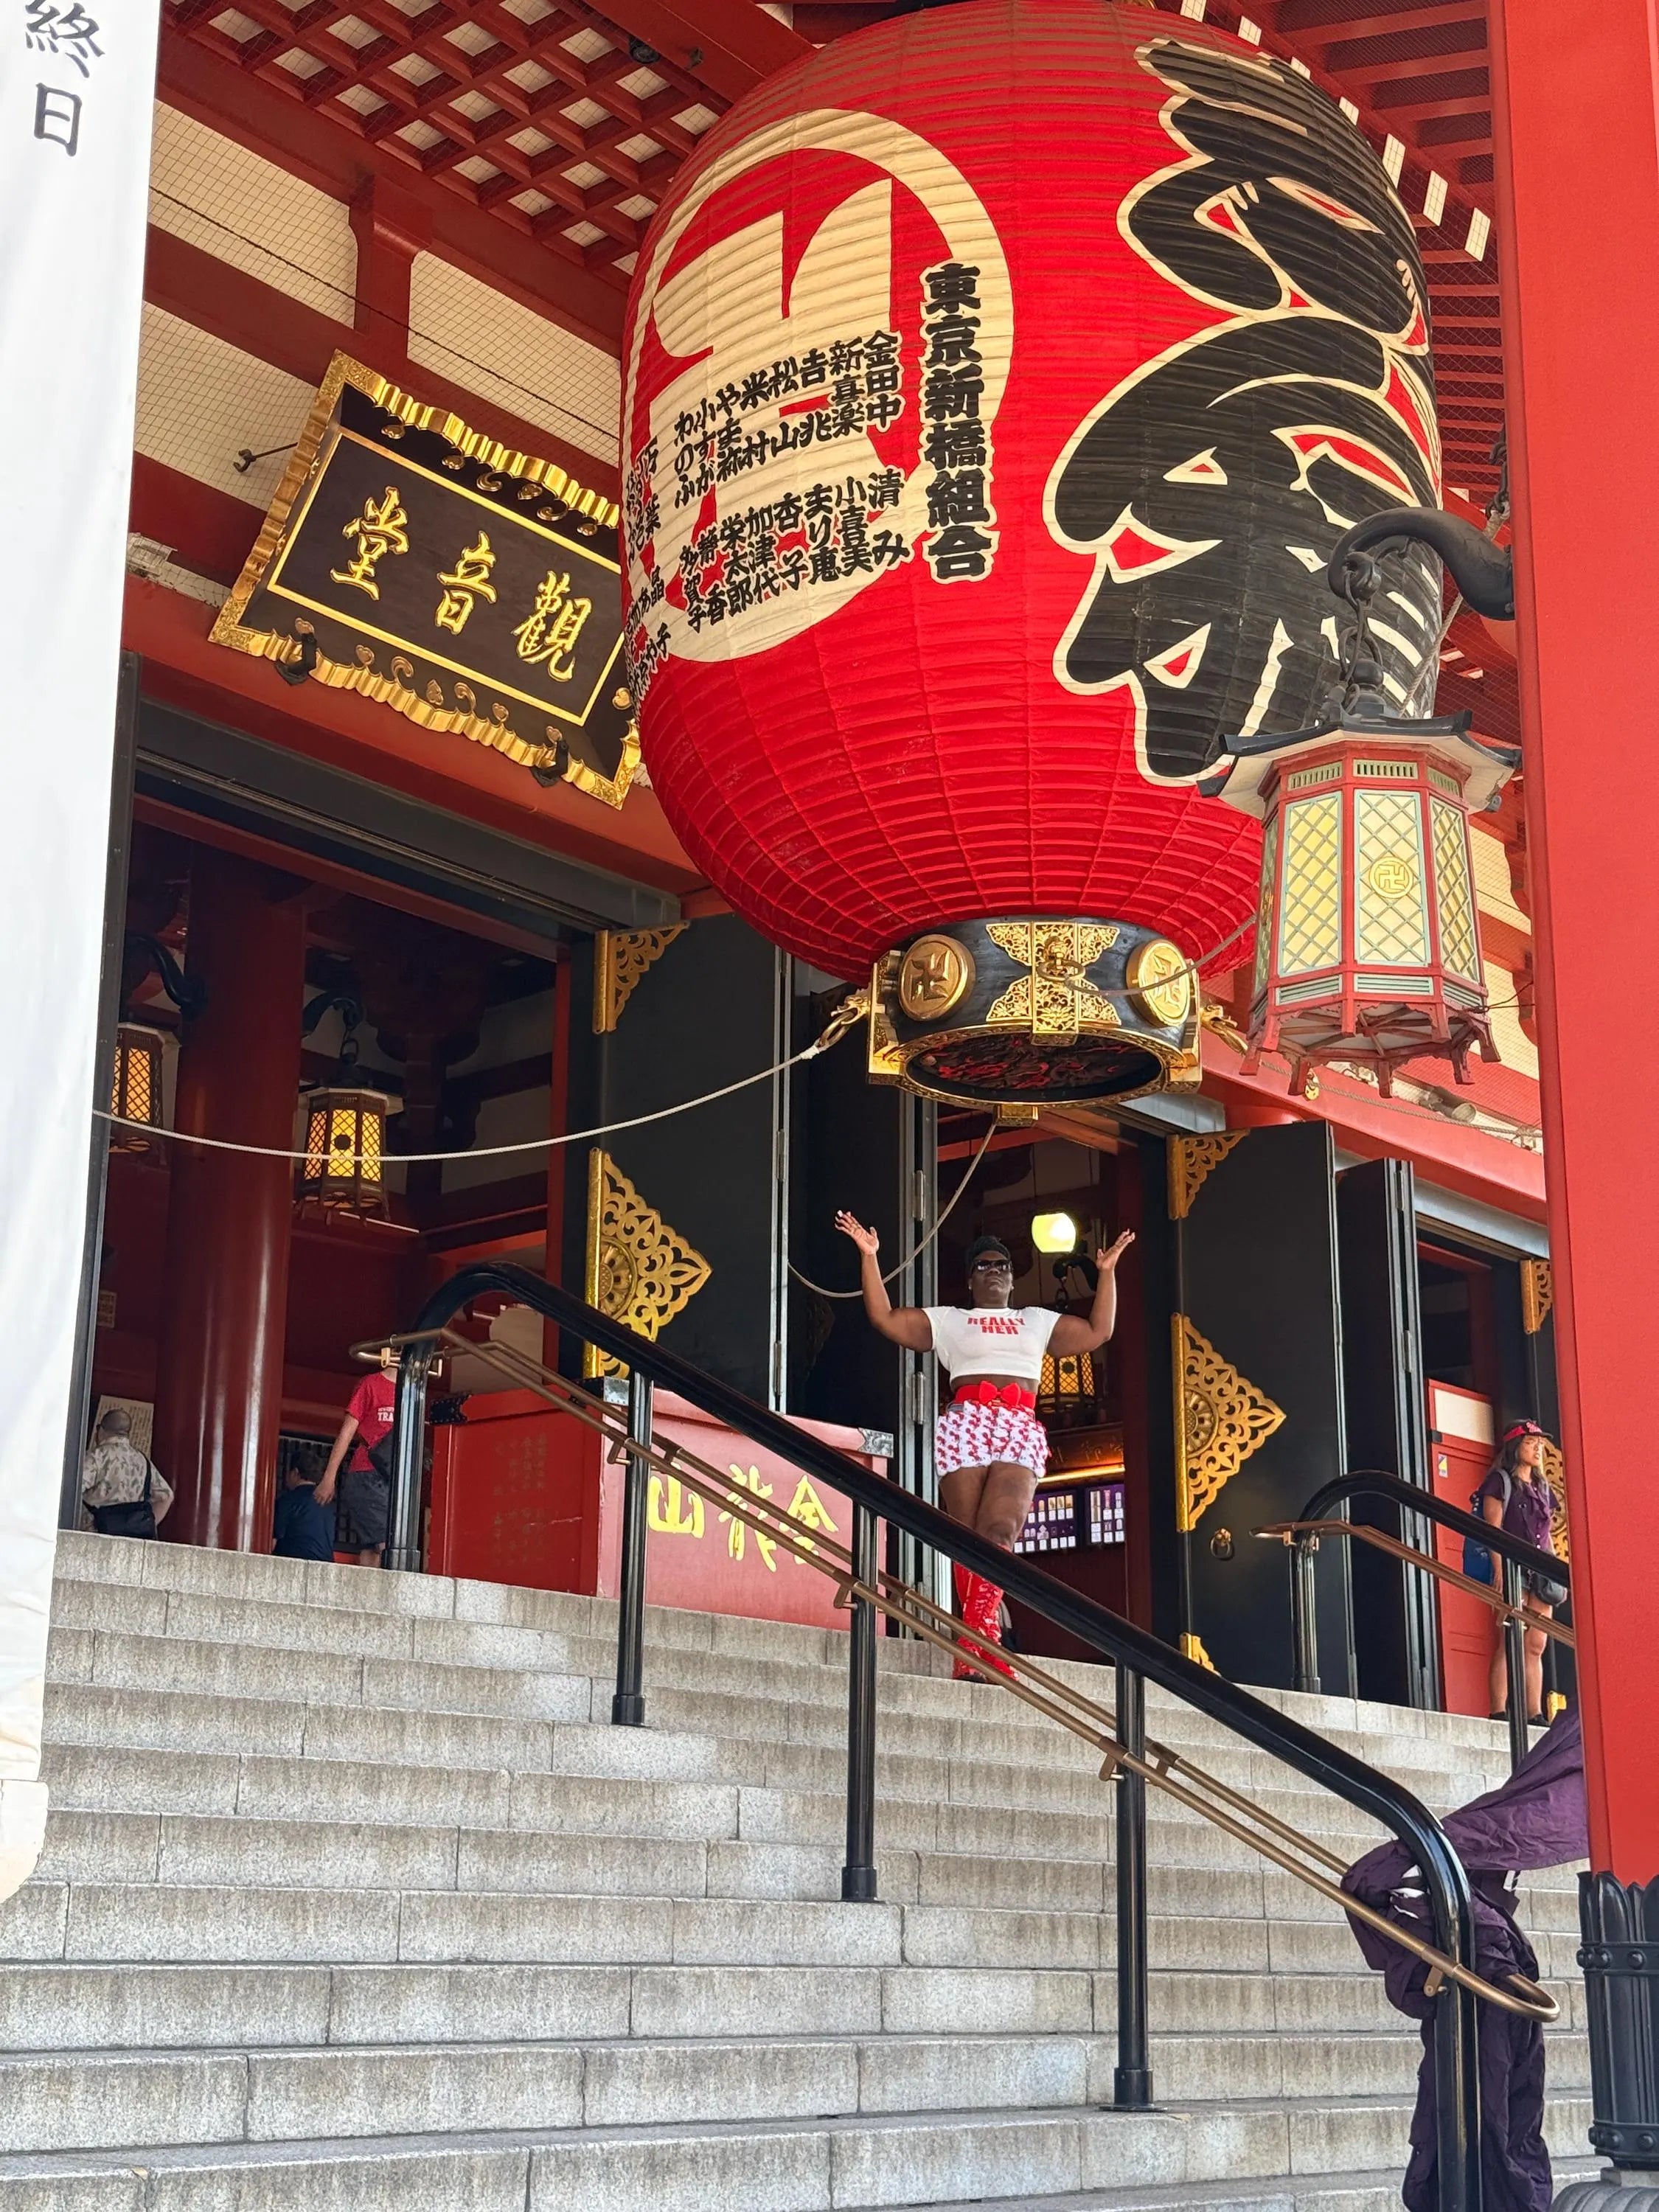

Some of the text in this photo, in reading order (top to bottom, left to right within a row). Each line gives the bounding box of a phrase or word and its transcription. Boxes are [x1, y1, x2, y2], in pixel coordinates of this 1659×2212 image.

[26, 0, 105, 156] 終日
[740, 370, 770, 465] 米村
[768, 356, 800, 456] 松山
[829, 336, 866, 438] 新喜楽
[863, 330, 901, 428] 金田中
[924, 262, 992, 580] 東京新橋組合
[720, 513, 754, 616] 栄太郎
[745, 504, 781, 603] 加津代
[773, 493, 809, 591] 杏子
[835, 476, 873, 577] 小喜美
[868, 468, 910, 566] 清み
[967, 1316, 1026, 1326] REALLY
[981, 1326, 1019, 1335] HER
